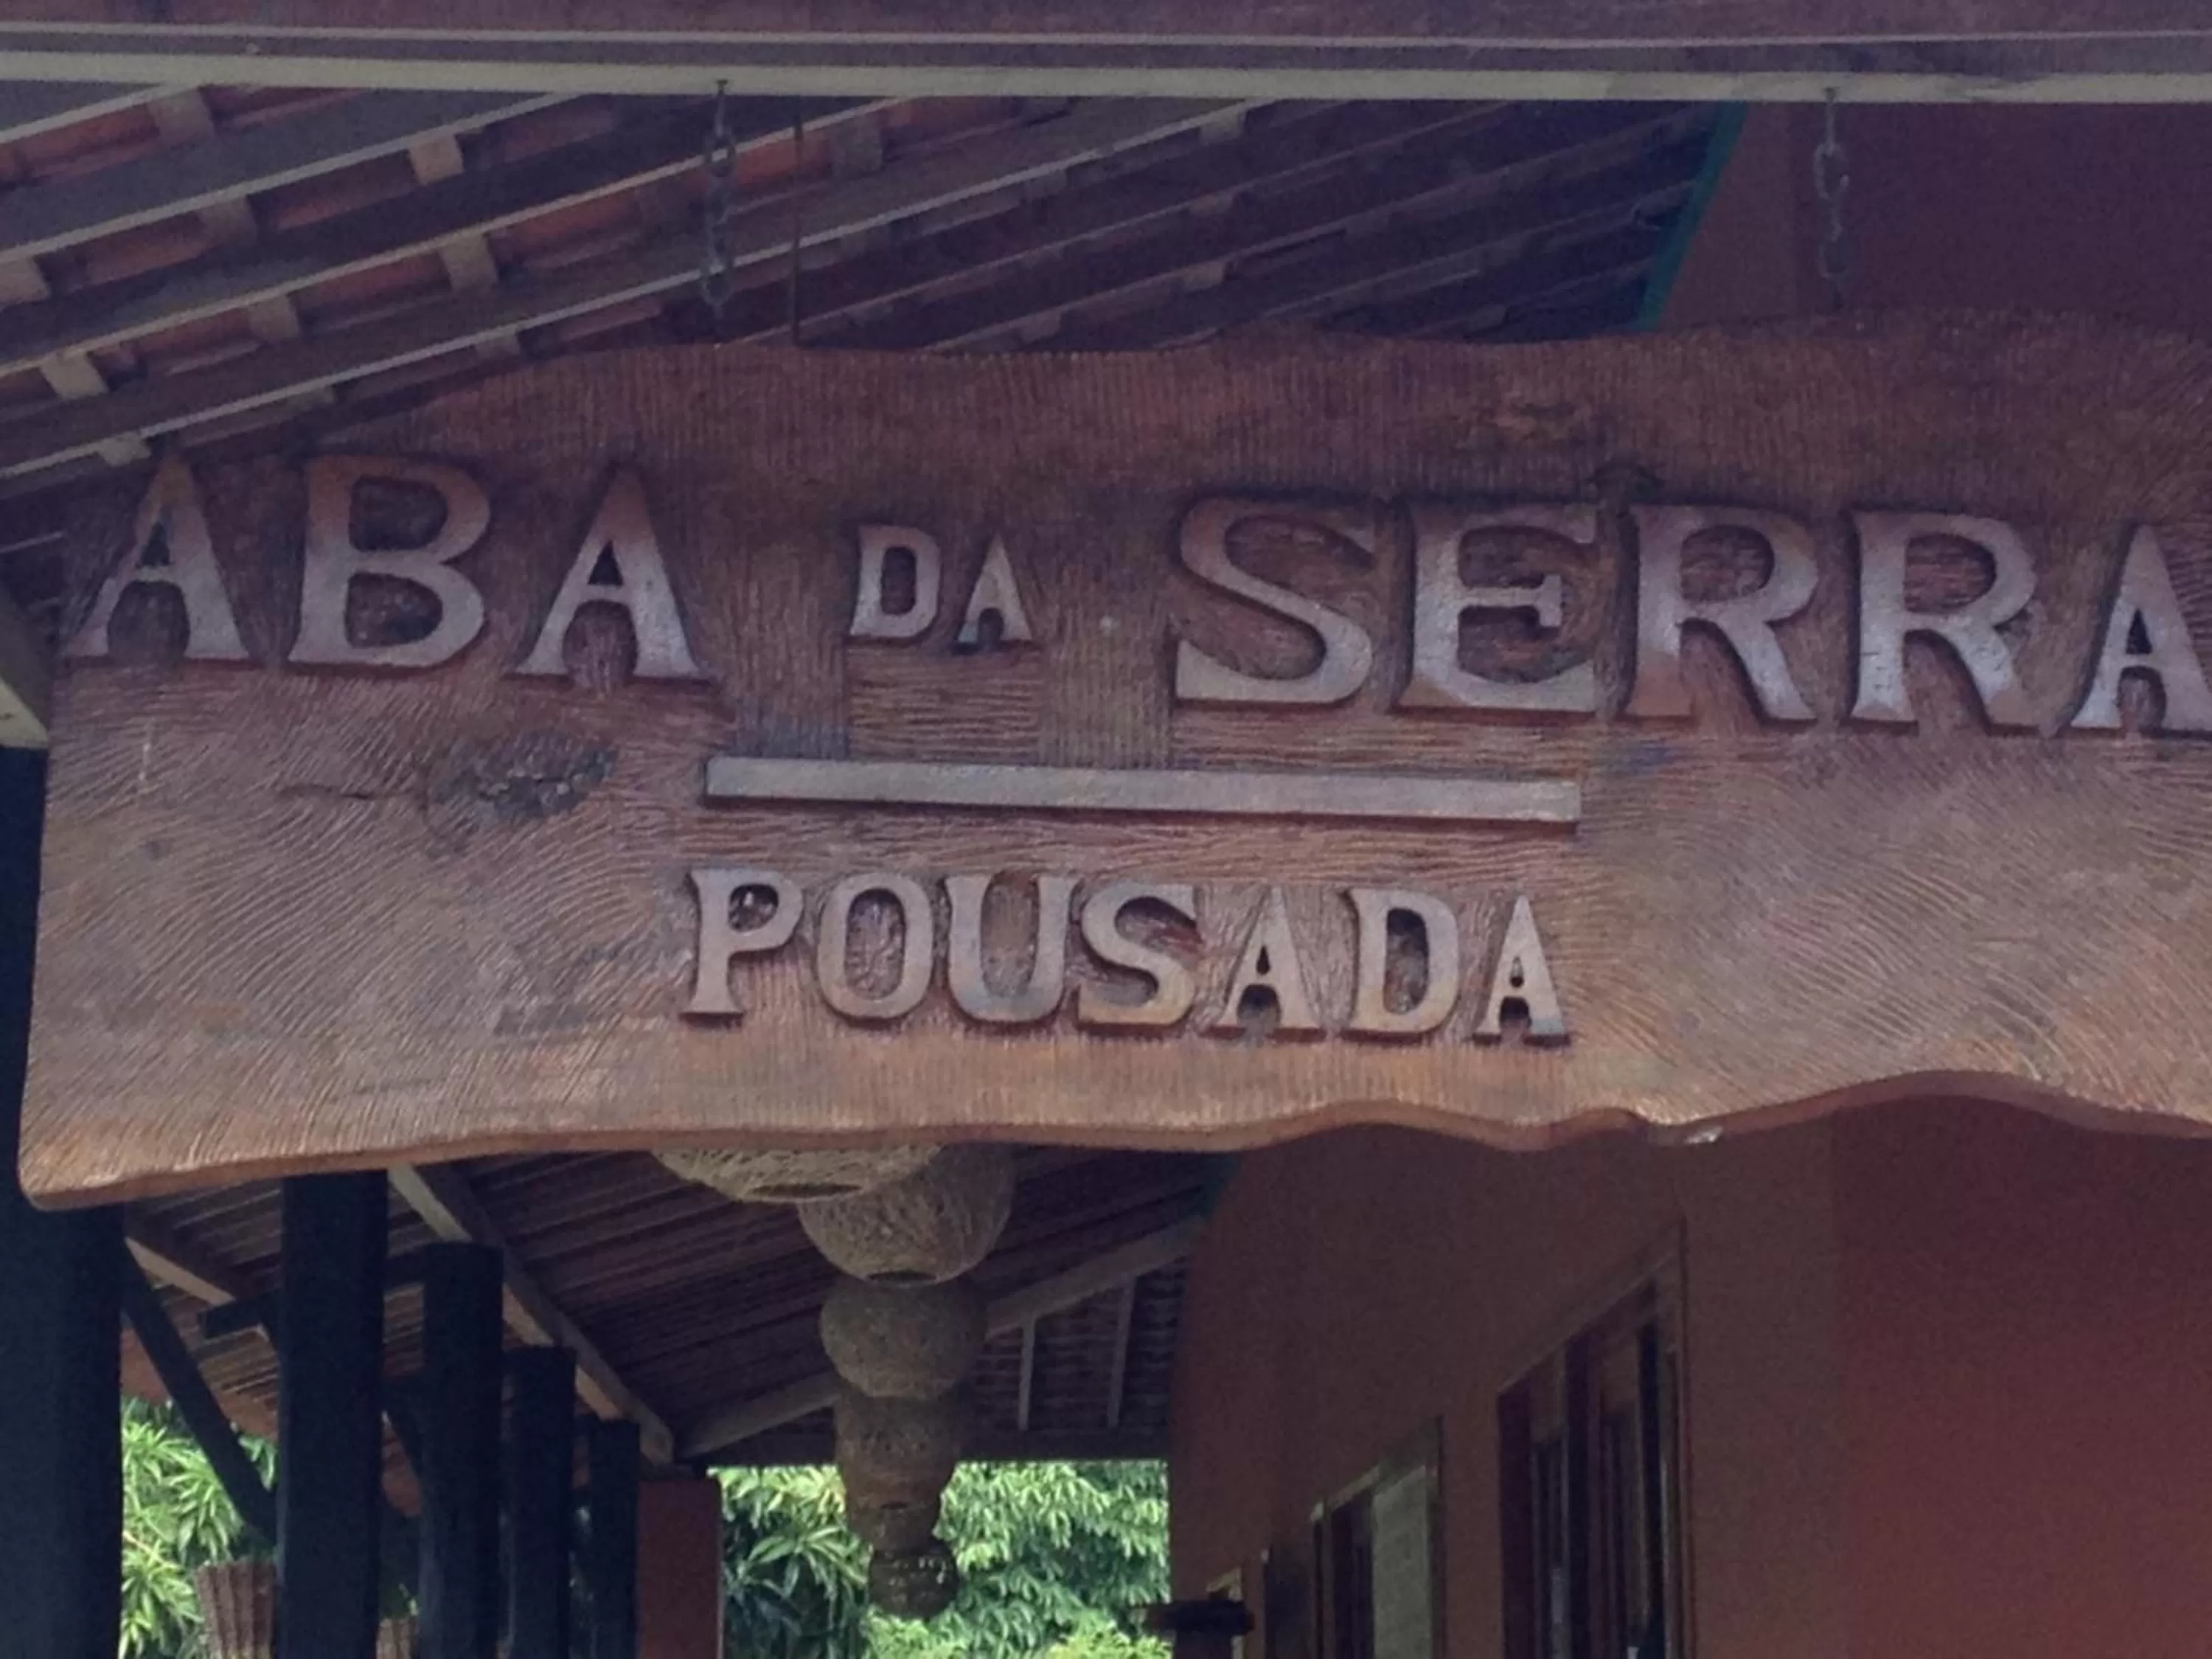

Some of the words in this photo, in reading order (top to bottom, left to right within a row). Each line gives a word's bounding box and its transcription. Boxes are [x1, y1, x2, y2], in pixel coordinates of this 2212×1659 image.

[63, 454, 709, 681] ABA
[849, 525, 1033, 644] DA
[1175, 497, 2212, 733] SERRA
[686, 867, 1568, 1041] POUSADA
